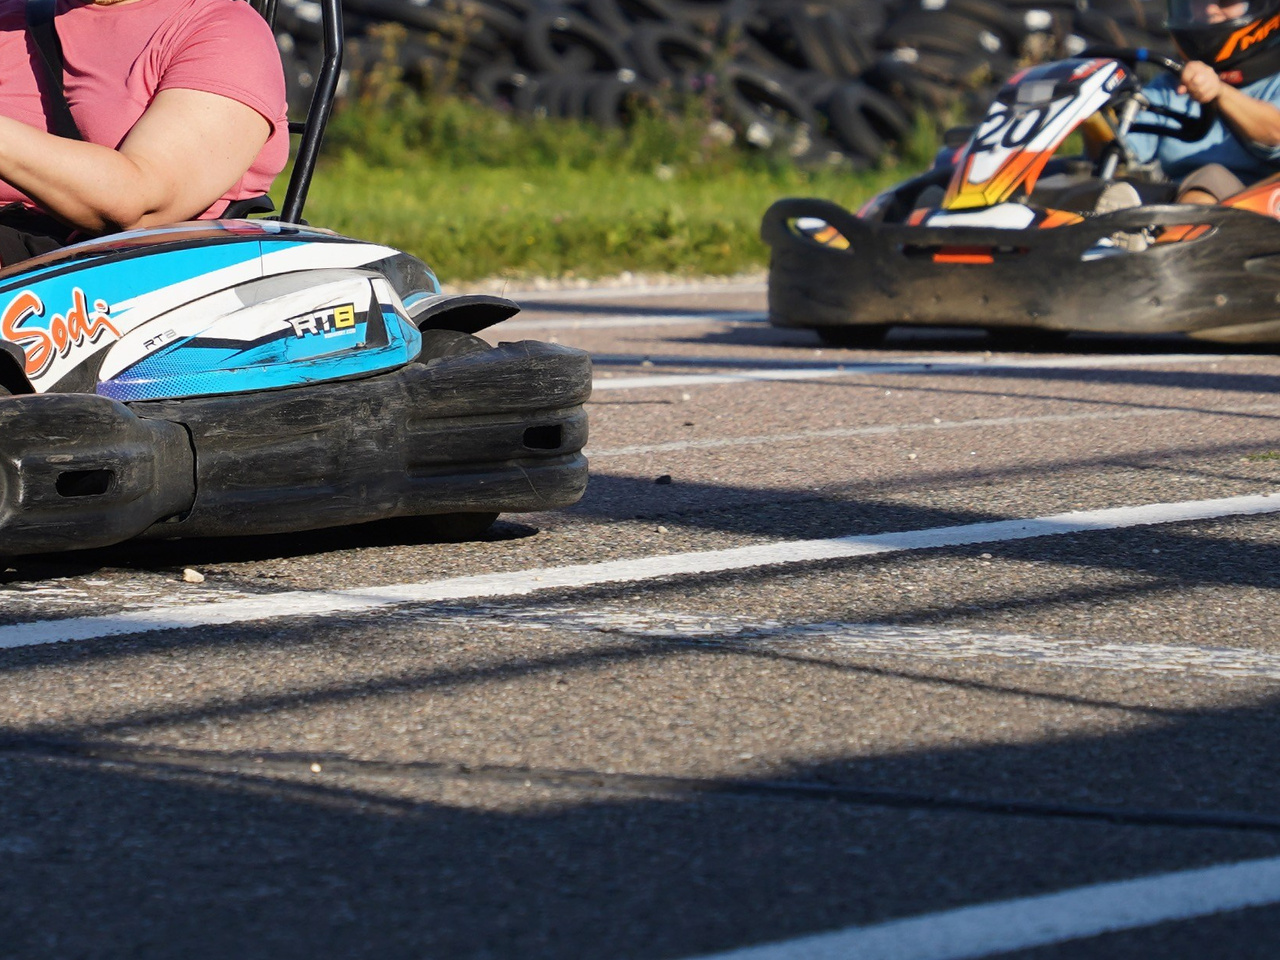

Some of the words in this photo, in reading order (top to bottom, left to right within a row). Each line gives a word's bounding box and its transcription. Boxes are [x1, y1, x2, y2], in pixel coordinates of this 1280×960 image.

[972, 106, 1049, 152] 20
[1, 289, 122, 377] Sodi
[287, 305, 354, 339] RT8
